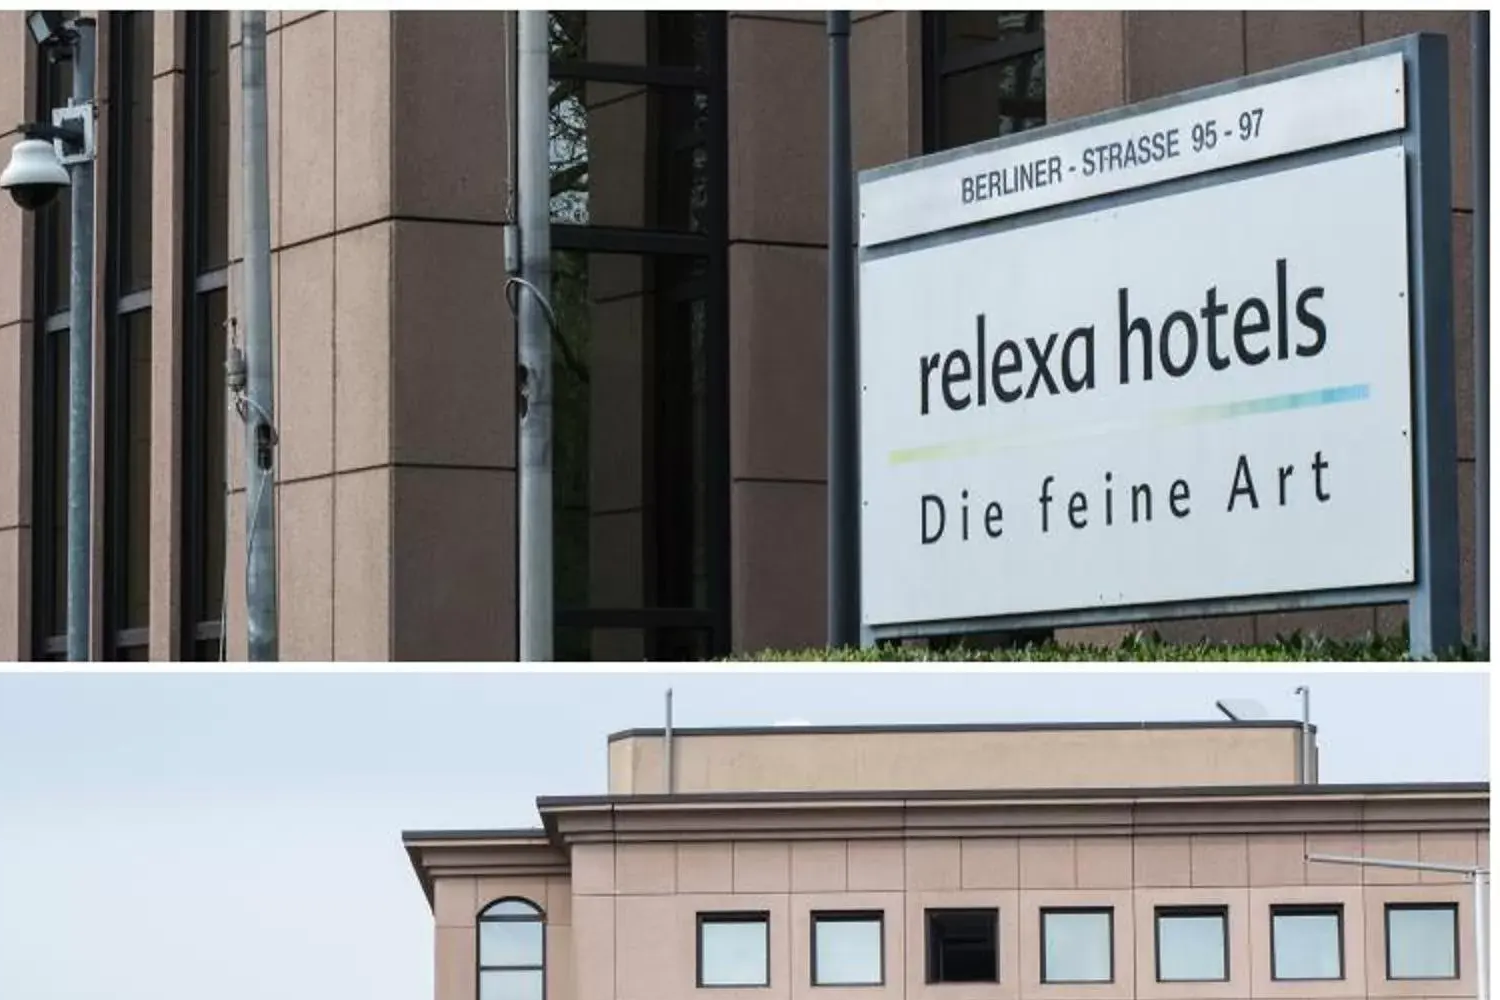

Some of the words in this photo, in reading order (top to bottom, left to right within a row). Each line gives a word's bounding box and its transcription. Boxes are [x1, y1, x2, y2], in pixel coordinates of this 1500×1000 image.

[961, 155, 1062, 204] BERLINER
[1082, 128, 1181, 177] STRASSE
[1191, 119, 1217, 152] 95
[1239, 107, 1264, 141] 97
[920, 313, 1096, 416] relexa
[1118, 258, 1328, 386] hotels
[921, 490, 1004, 545] Die
[1040, 472, 1191, 533] feine
[1227, 450, 1330, 514] Art
